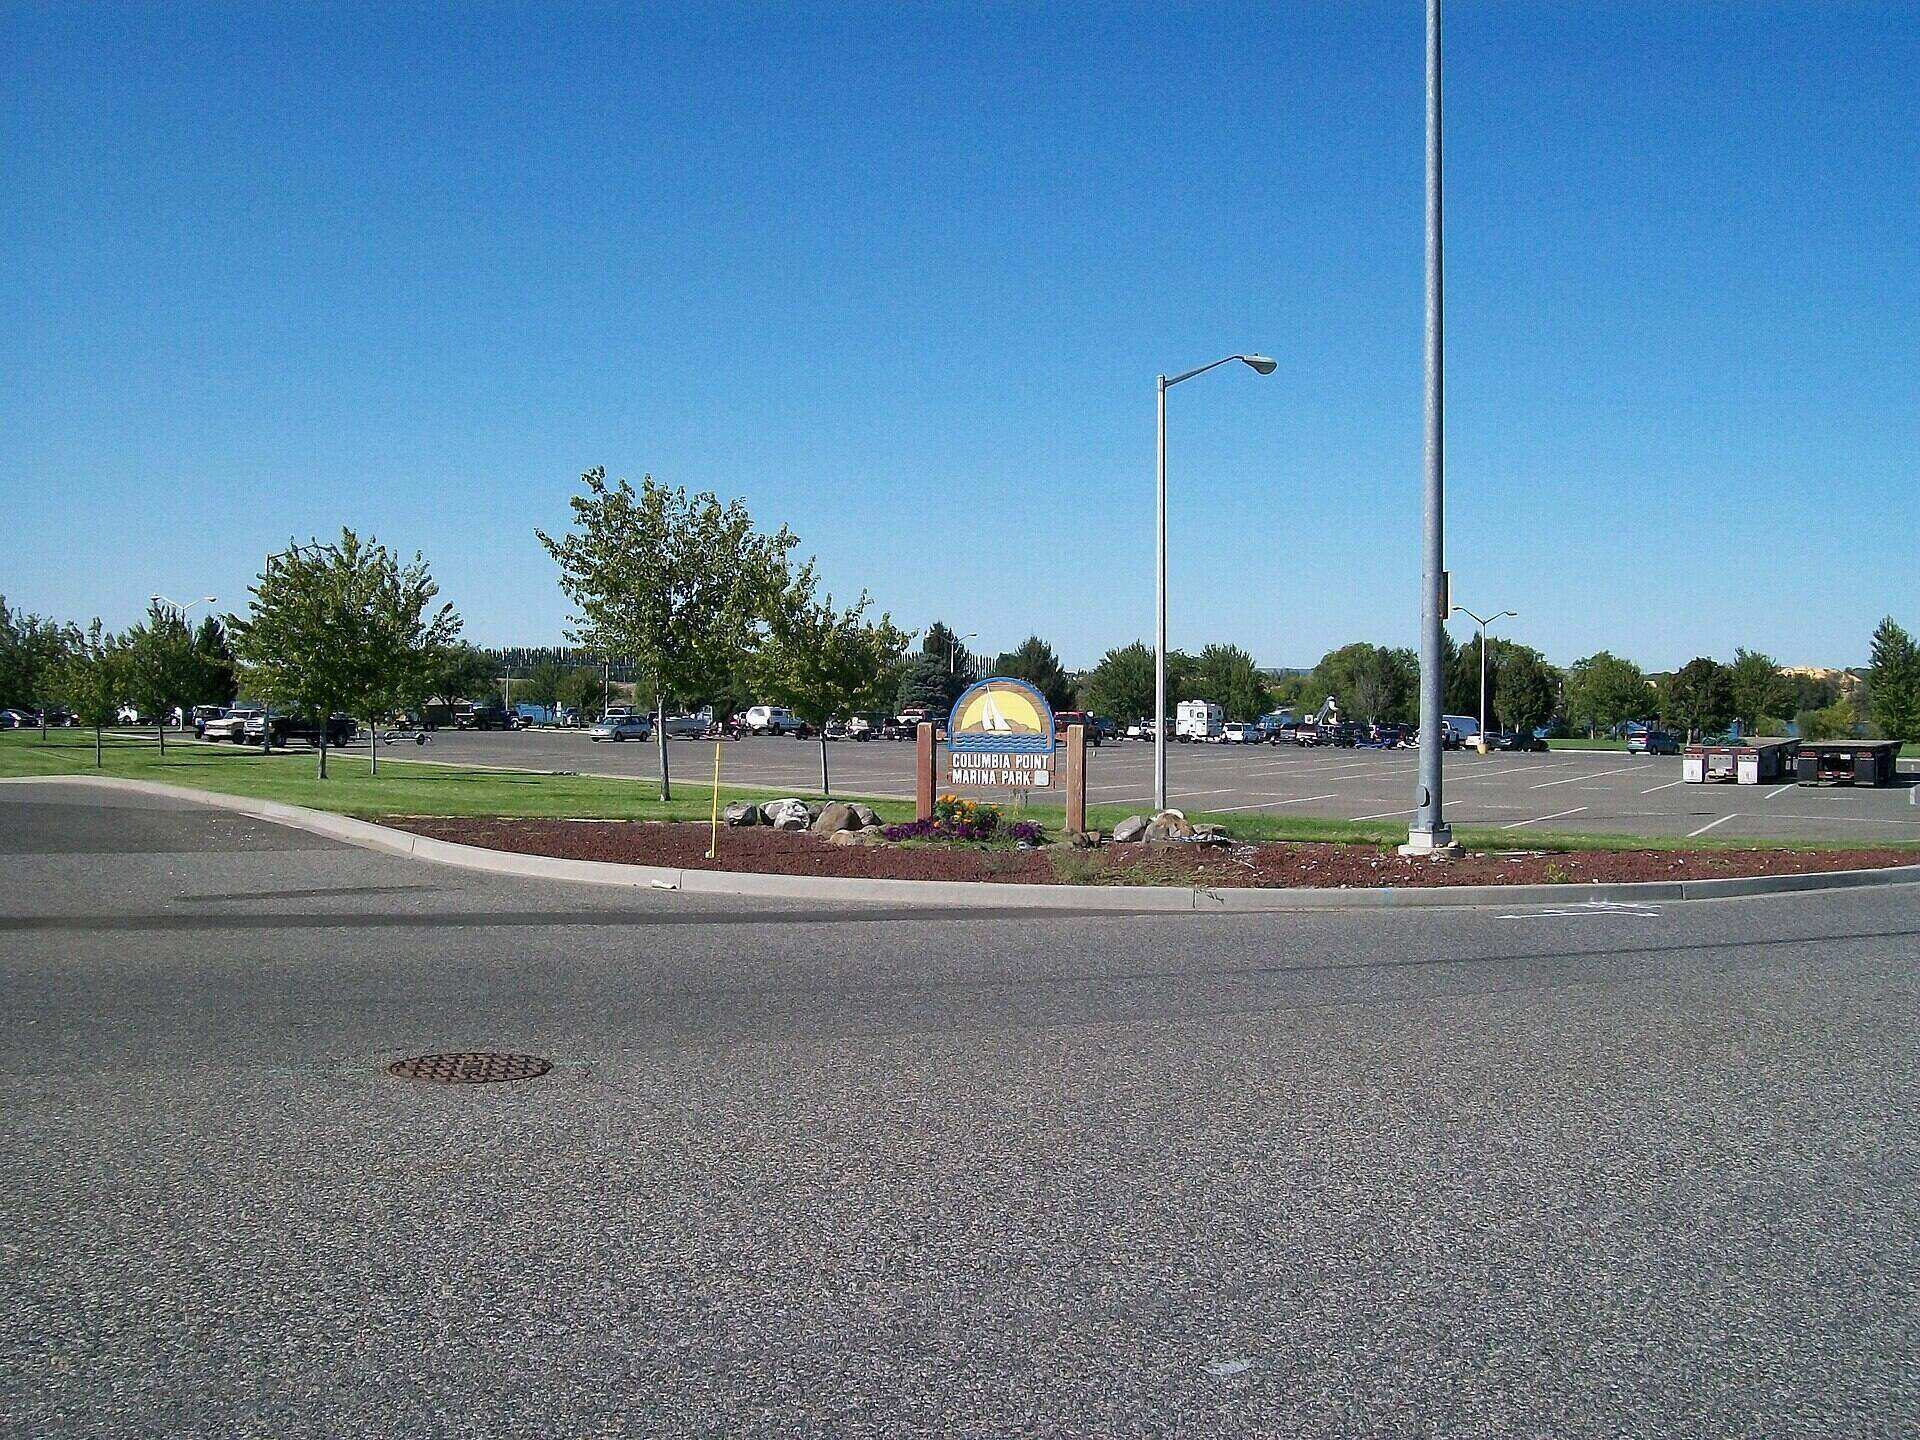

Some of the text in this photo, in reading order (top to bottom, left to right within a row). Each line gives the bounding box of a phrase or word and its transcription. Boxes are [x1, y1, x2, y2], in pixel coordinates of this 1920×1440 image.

[952, 753, 1049, 770] COLUMBIA POINT
[952, 769, 1031, 785] MARINA PARK
